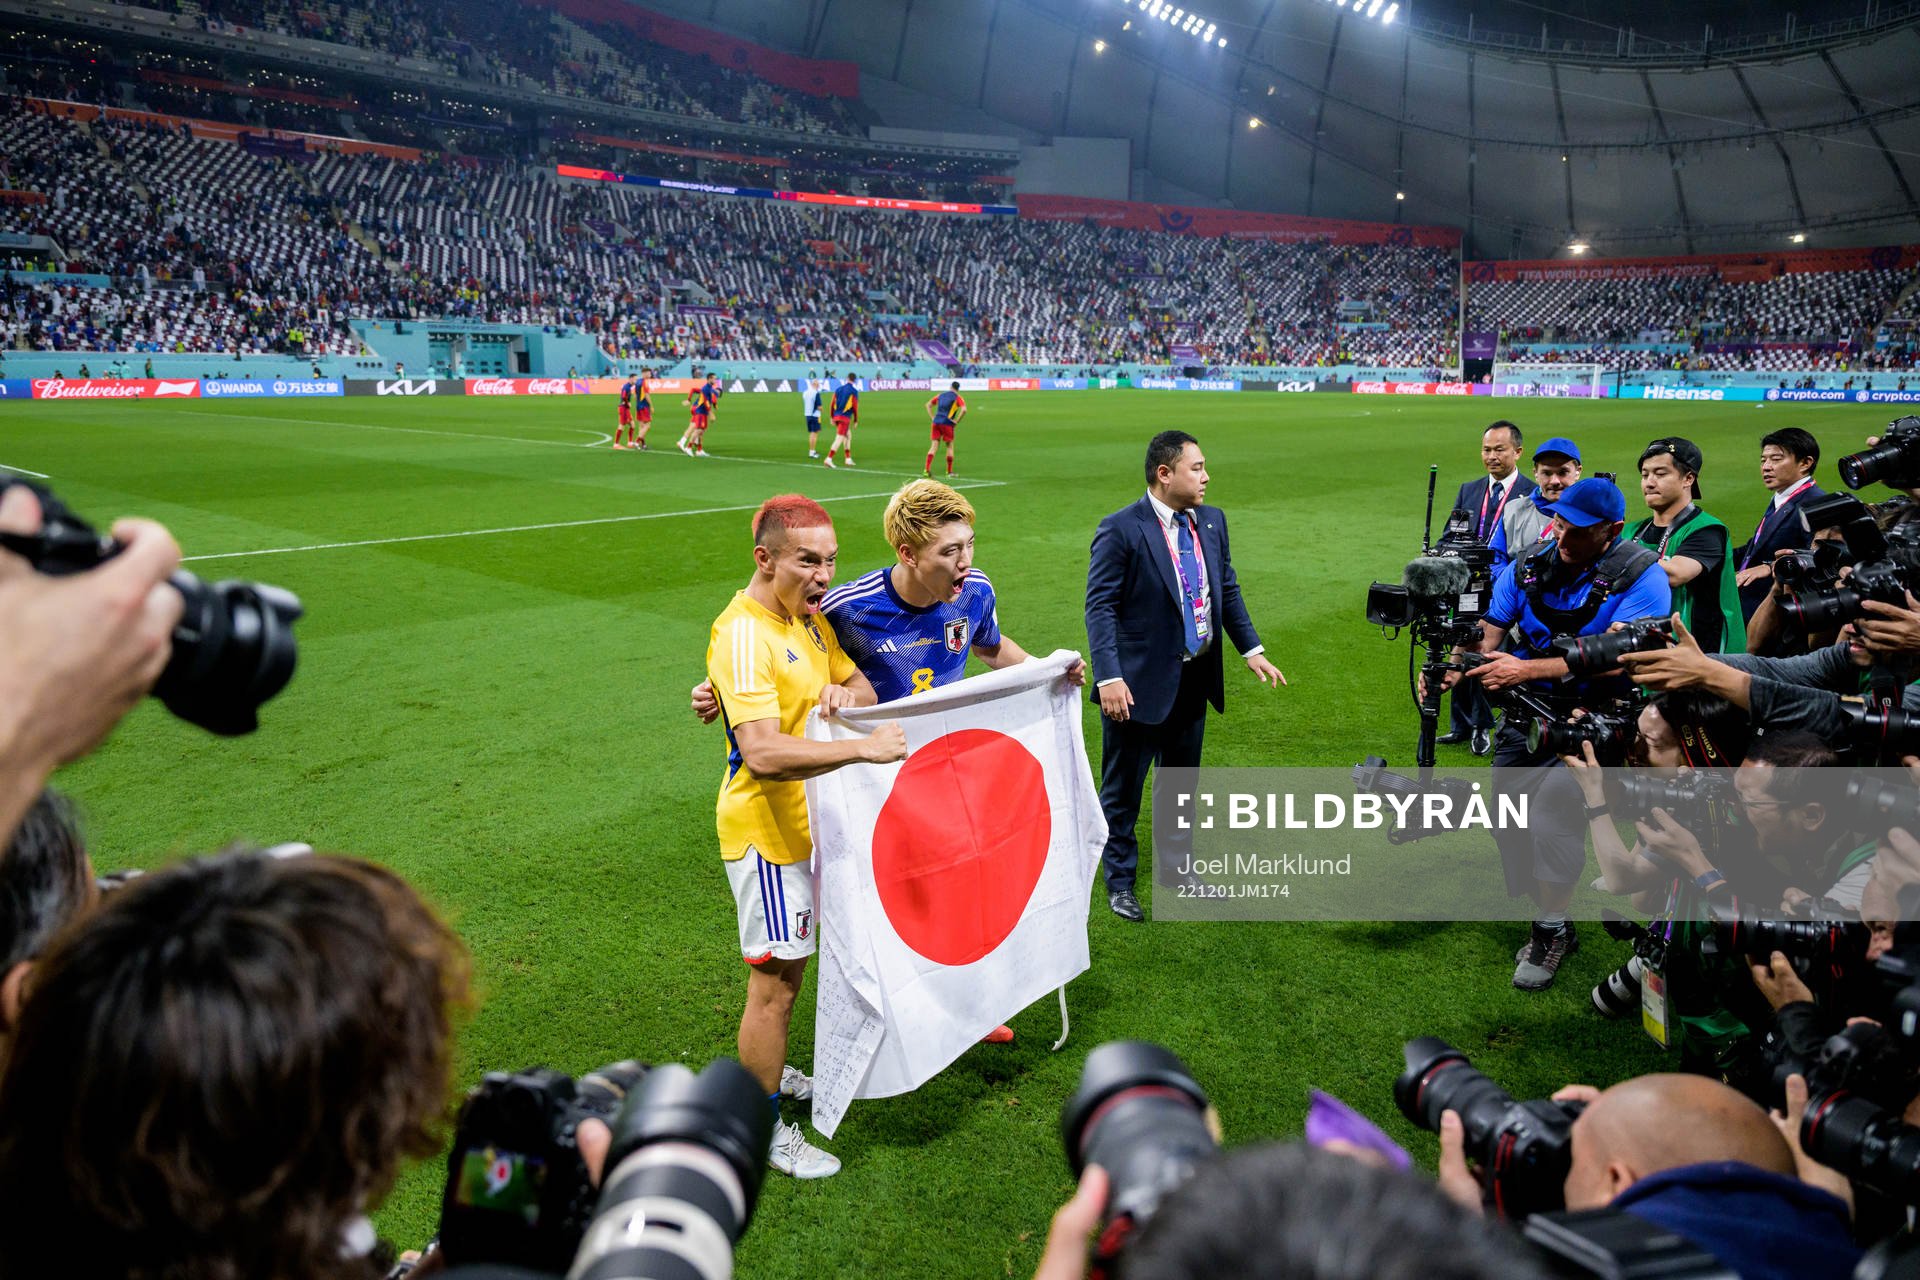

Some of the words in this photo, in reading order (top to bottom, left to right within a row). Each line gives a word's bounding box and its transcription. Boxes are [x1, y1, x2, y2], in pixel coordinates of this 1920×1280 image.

[1545, 268, 1589, 280] WORLD
[1590, 268, 1612, 279] CUP
[35, 380, 145, 398] Budweiser
[222, 383, 264, 393] WANDA
[376, 380, 437, 395] KIA
[473, 379, 516, 395] Coca-Cola
[528, 379, 567, 394] Coca-Cola
[870, 380, 897, 390] QATAR
[899, 380, 930, 390] AIRWAYS
[1643, 384, 1725, 401] Hisense
[1782, 390, 1845, 402] crypto.com
[911, 667, 934, 695] 8
